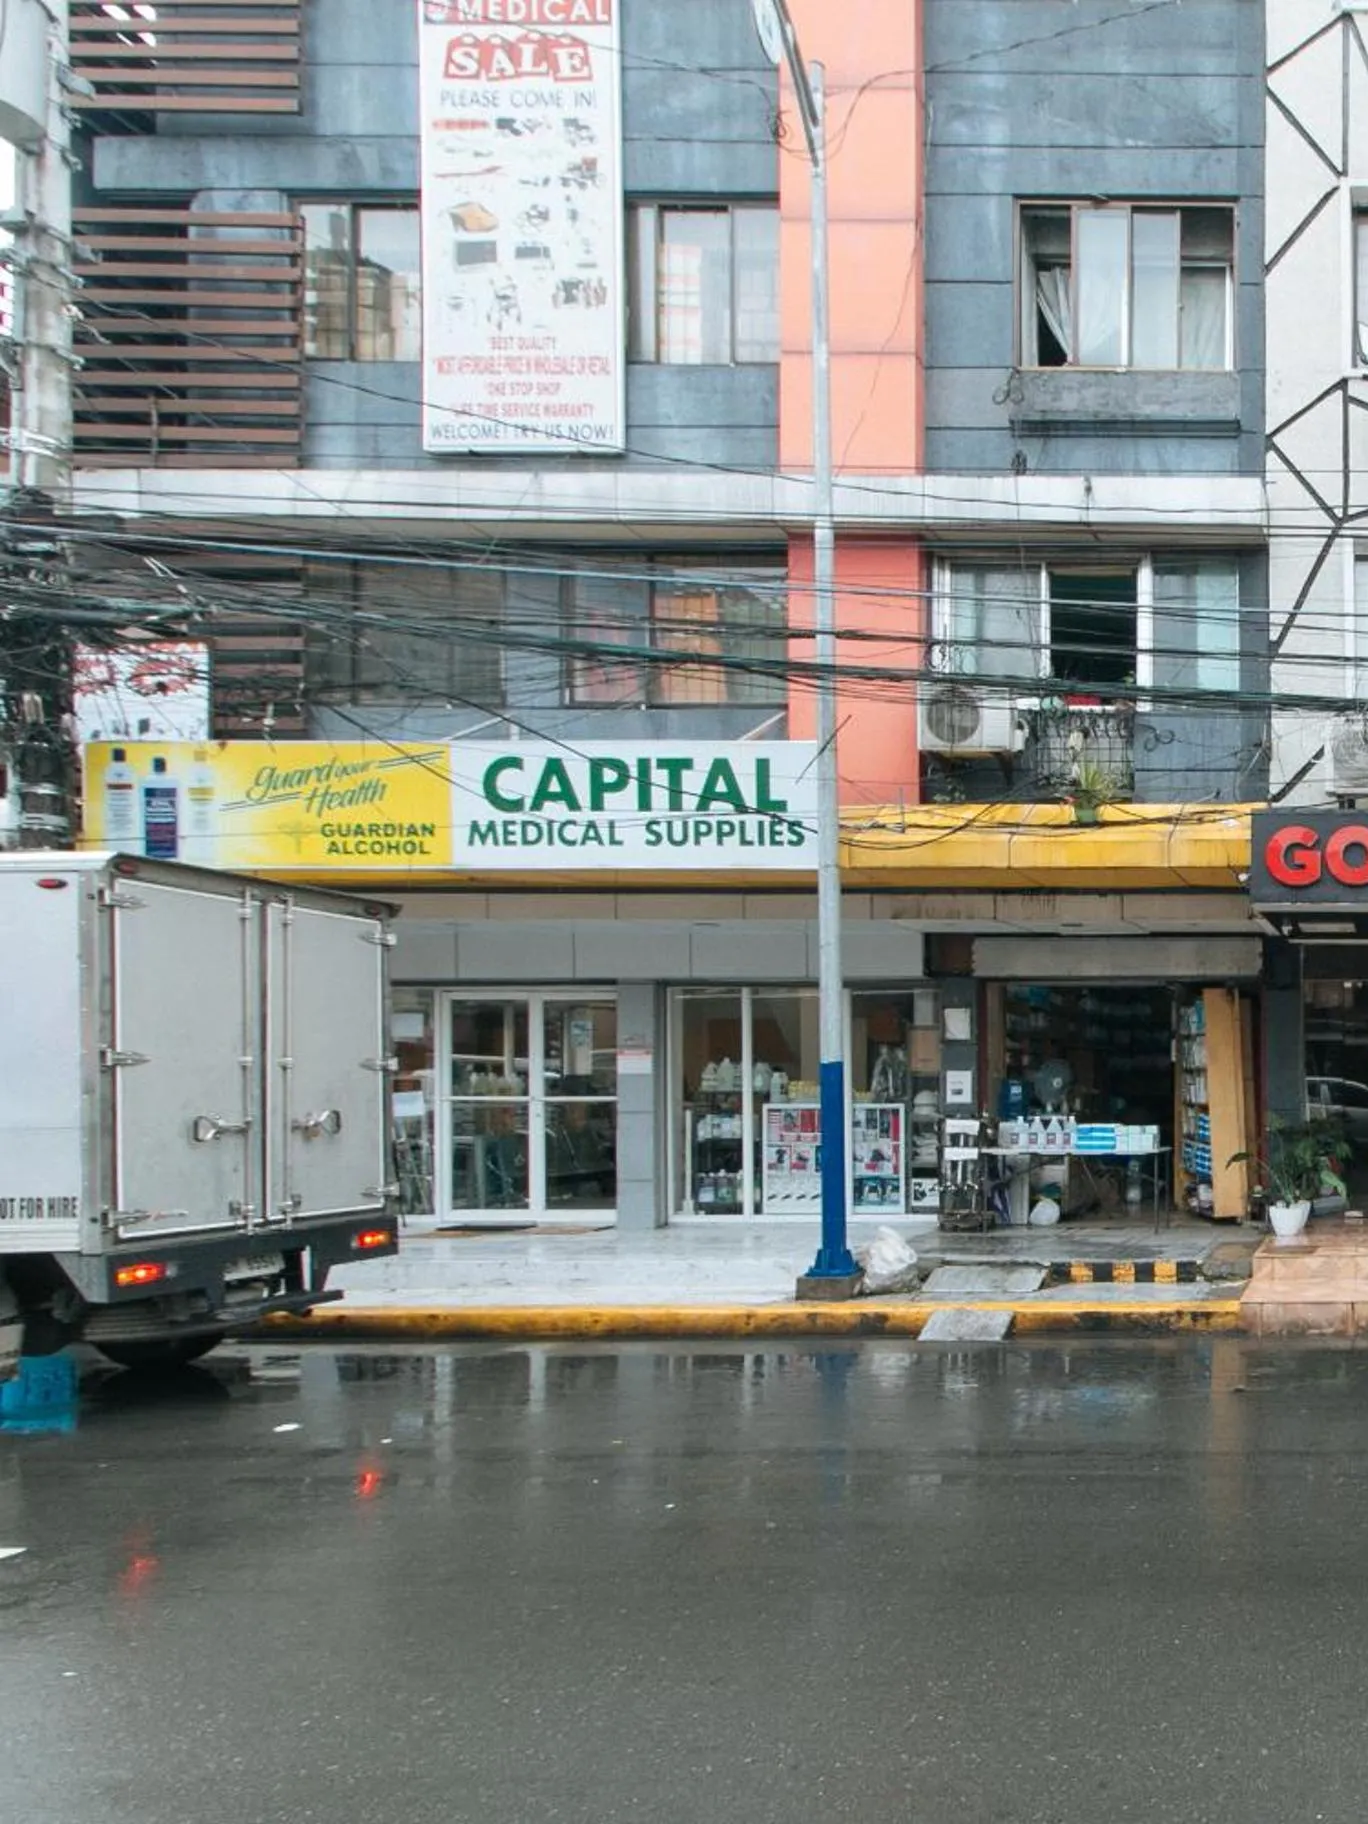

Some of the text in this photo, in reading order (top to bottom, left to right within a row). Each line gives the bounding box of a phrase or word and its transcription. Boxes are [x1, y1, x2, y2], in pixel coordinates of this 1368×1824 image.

[457, 0, 610, 22] MEDICAL
[447, 42, 591, 79] SALE
[440, 89, 501, 108] PLEASE
[510, 89, 562, 108] COME
[516, 336, 557, 350] QUALITY
[509, 381, 534, 396] STOP
[536, 381, 562, 396] SHOP
[500, 402, 541, 418] SERVICE
[542, 402, 595, 418] WARRANTY
[544, 423, 563, 440] US
[481, 756, 788, 813] CAPITAL
[299, 777, 388, 818] Health
[320, 823, 435, 839] GUARDIAN
[467, 819, 806, 847] MEDICAL SUPPLIES
[326, 839, 431, 856] ALCOHOL
[0, 1196, 79, 1220] OT FOR HIRE
